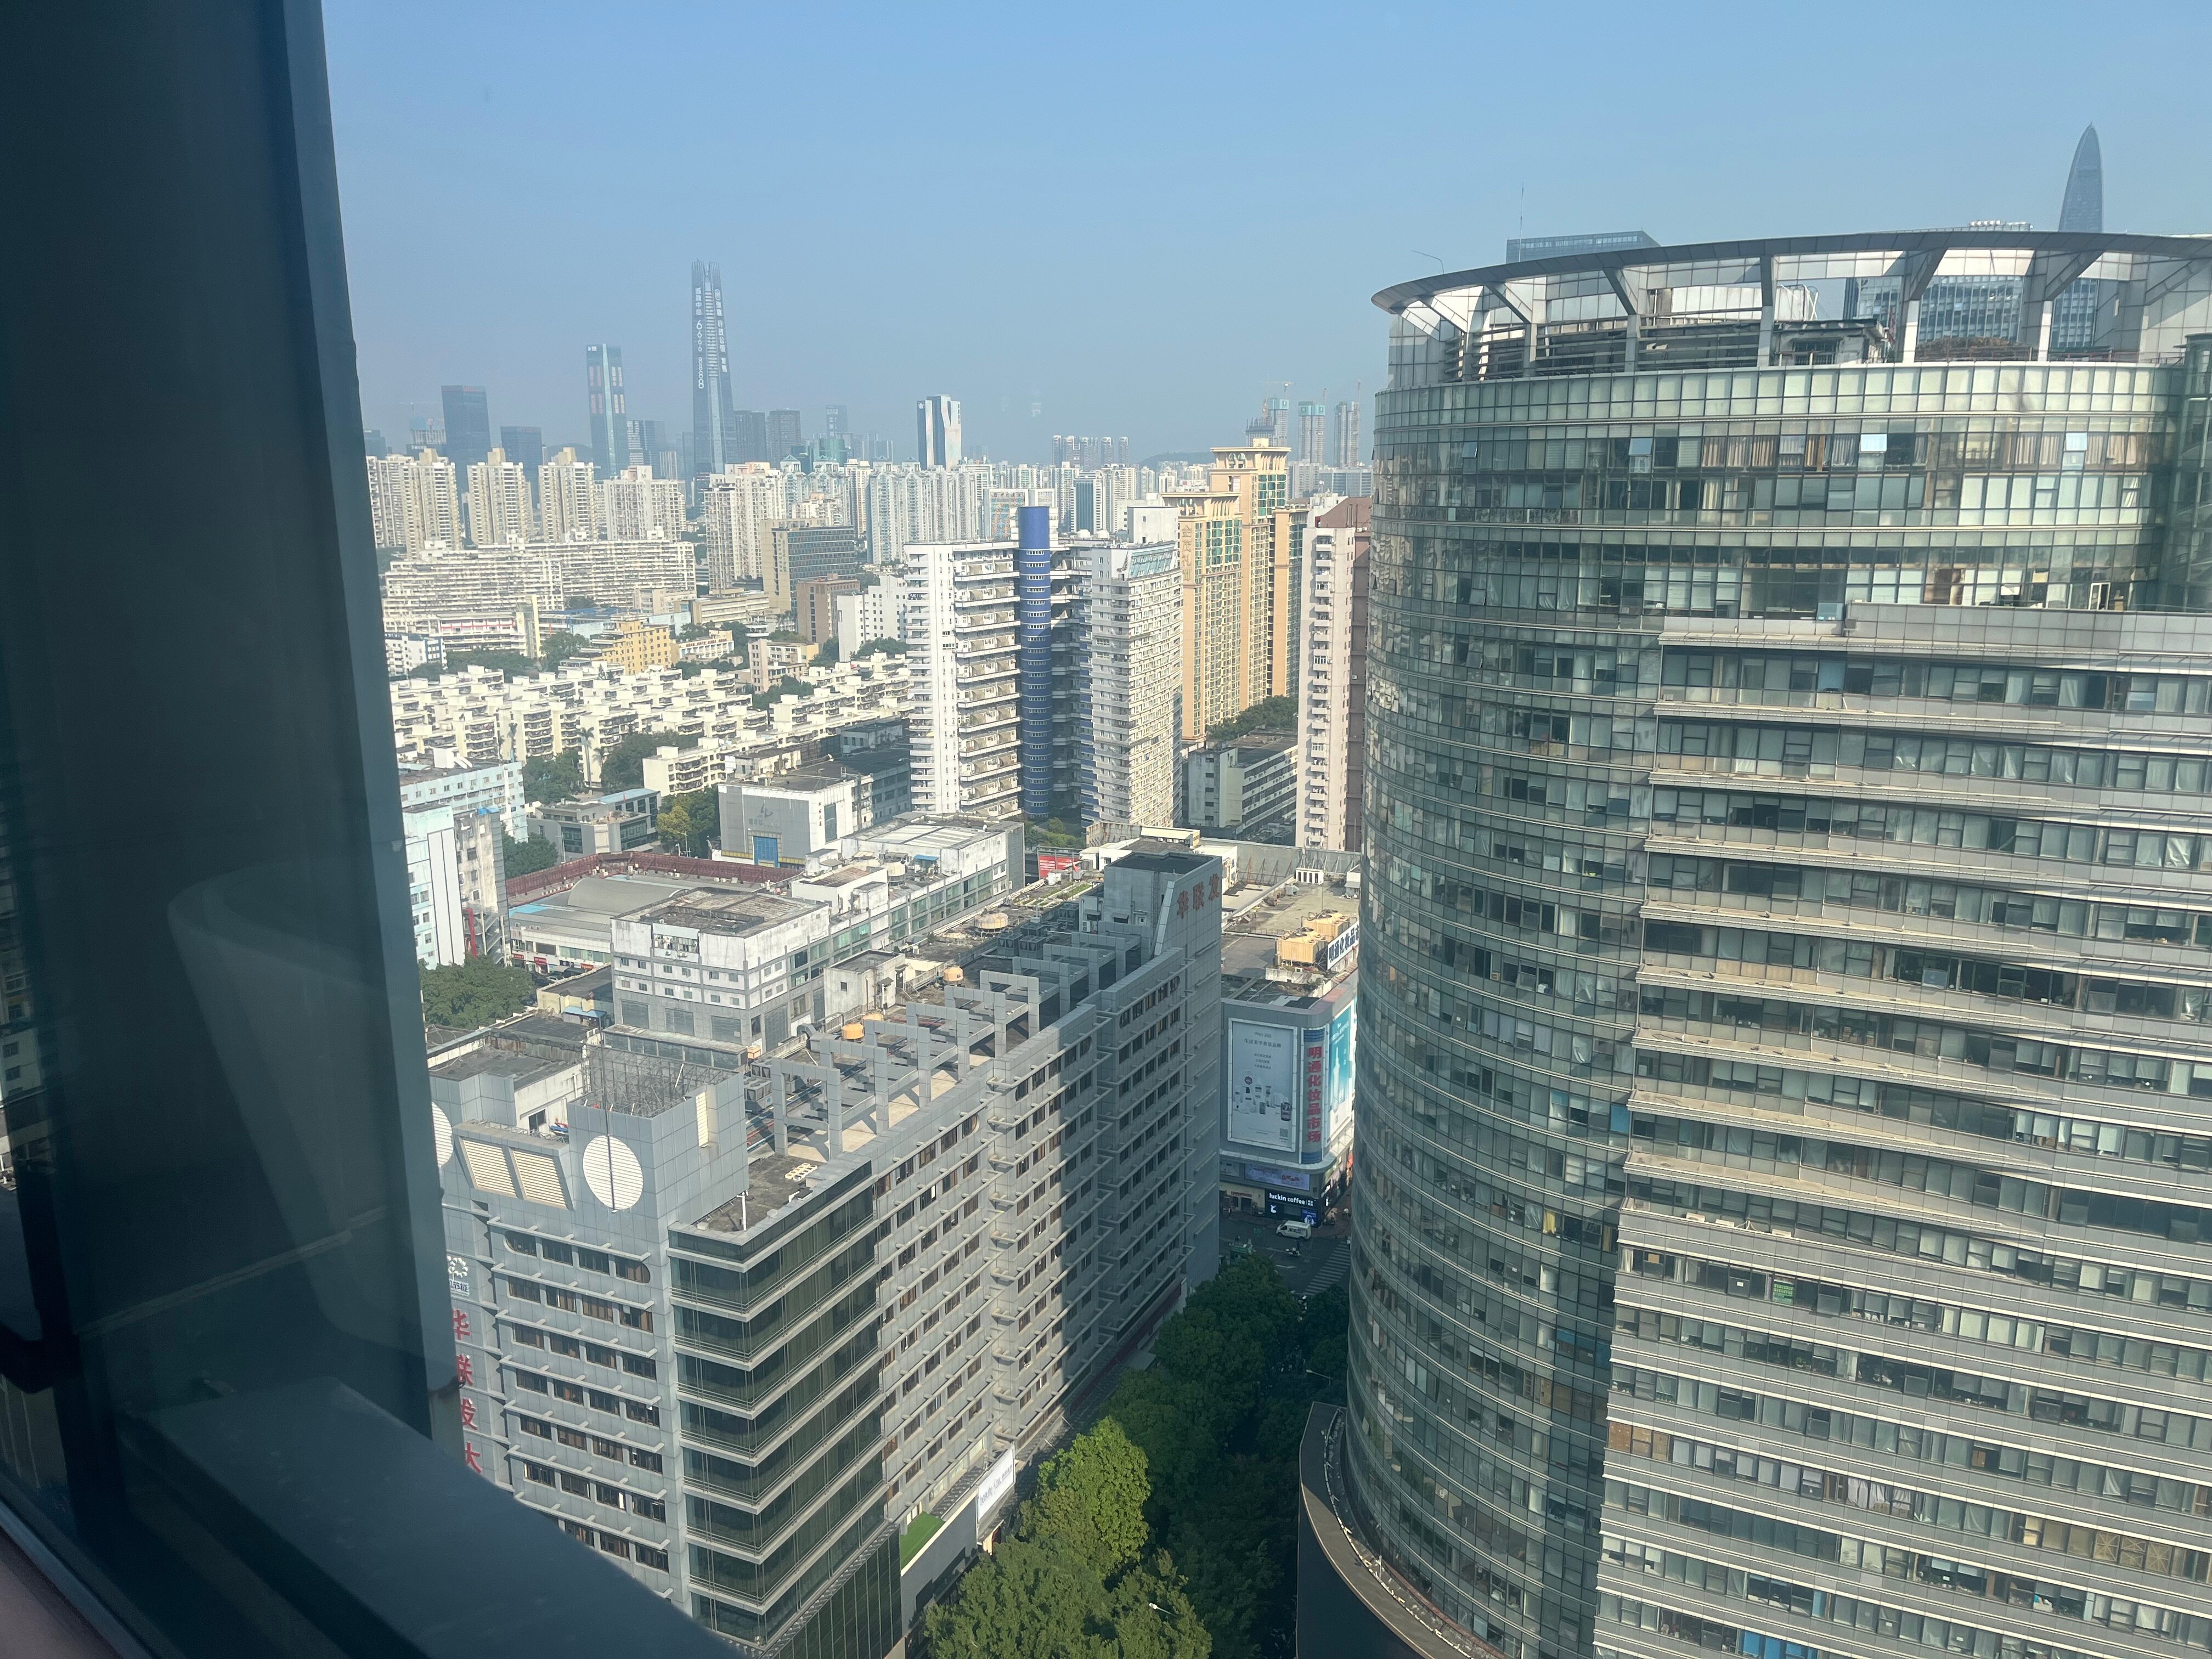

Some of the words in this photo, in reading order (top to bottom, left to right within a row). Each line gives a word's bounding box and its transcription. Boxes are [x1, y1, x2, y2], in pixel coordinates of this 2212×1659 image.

[1307, 1046, 1322, 1143] 明通化妆品市场
[1269, 1192, 1286, 1201] luckin
